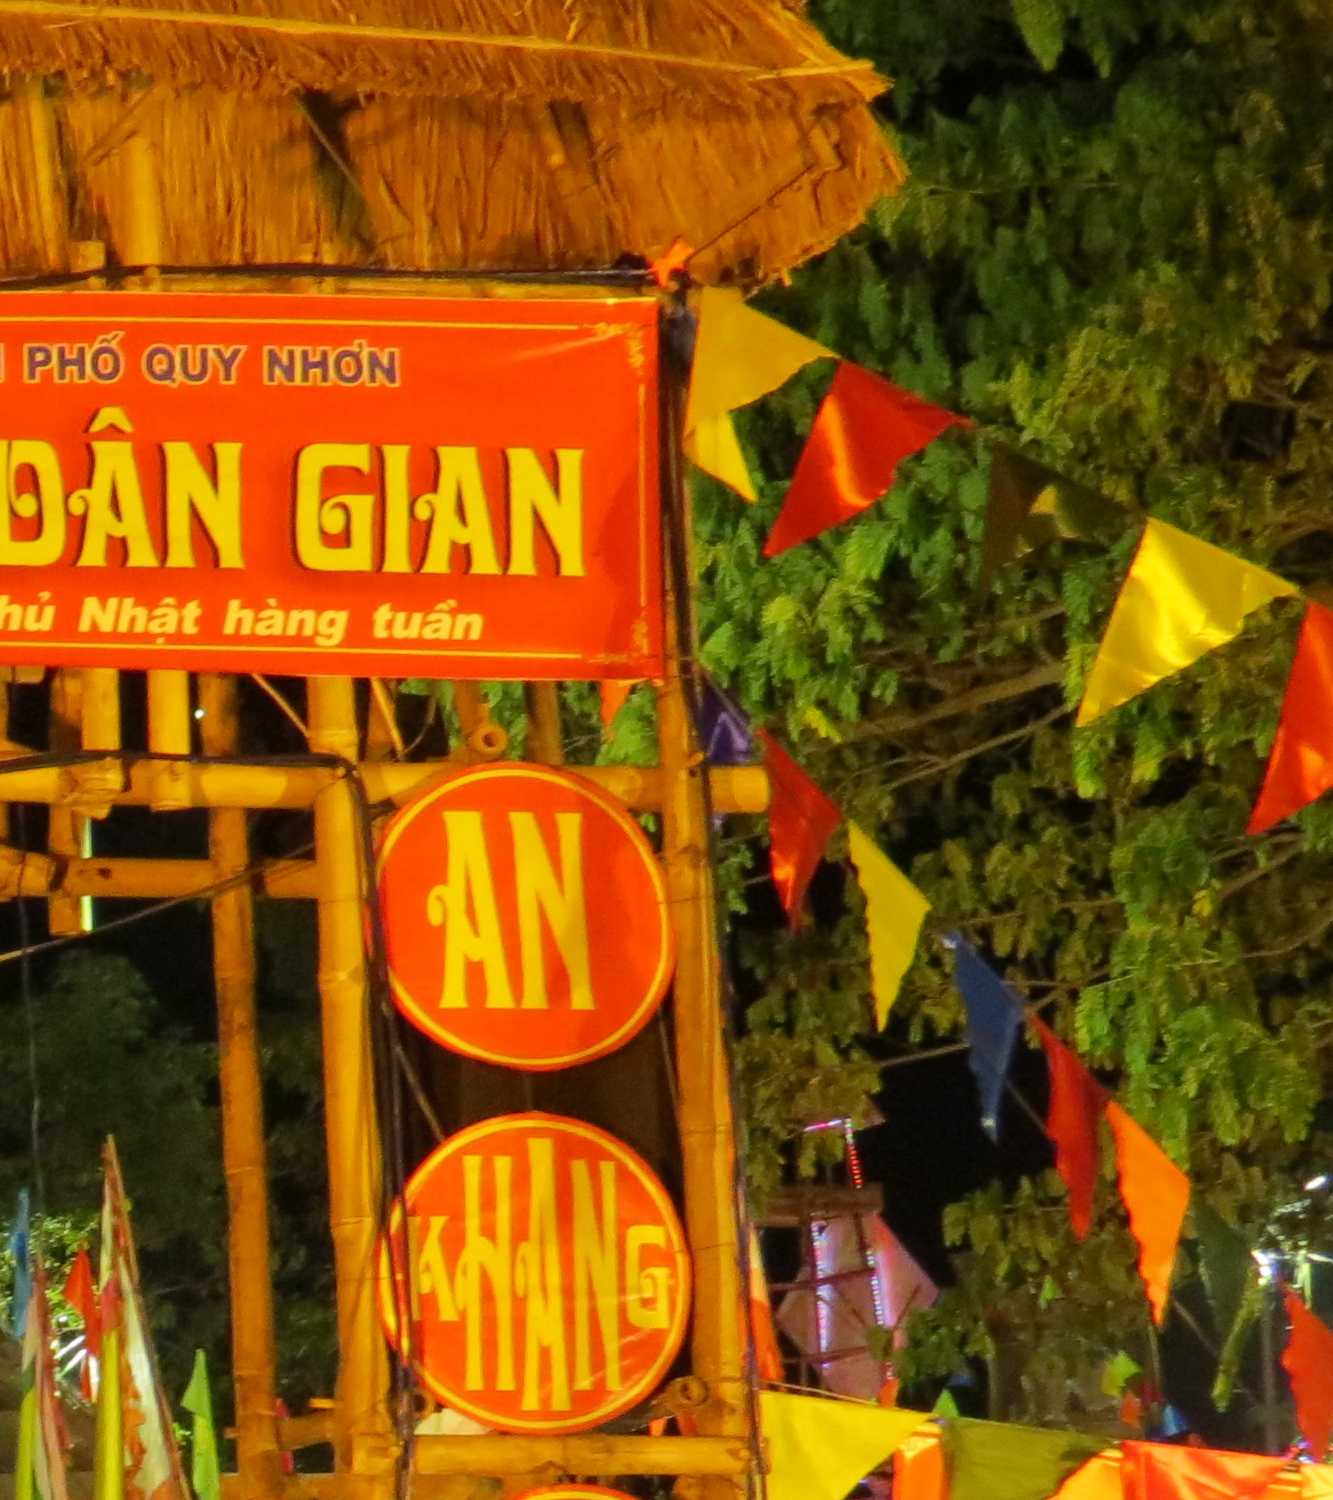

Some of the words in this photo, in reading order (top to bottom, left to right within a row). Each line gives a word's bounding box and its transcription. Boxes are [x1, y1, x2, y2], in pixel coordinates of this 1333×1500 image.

[23, 331, 125, 384] PHỐ
[141, 343, 248, 388] QUY
[262, 339, 401, 388] NHƠN
[297, 444, 584, 576] GIAN
[78, 596, 201, 645] Nhật
[223, 598, 348, 646] hàng
[373, 600, 484, 640] tuần
[427, 811, 594, 1010] AN
[408, 1137, 672, 1411] KHANG
